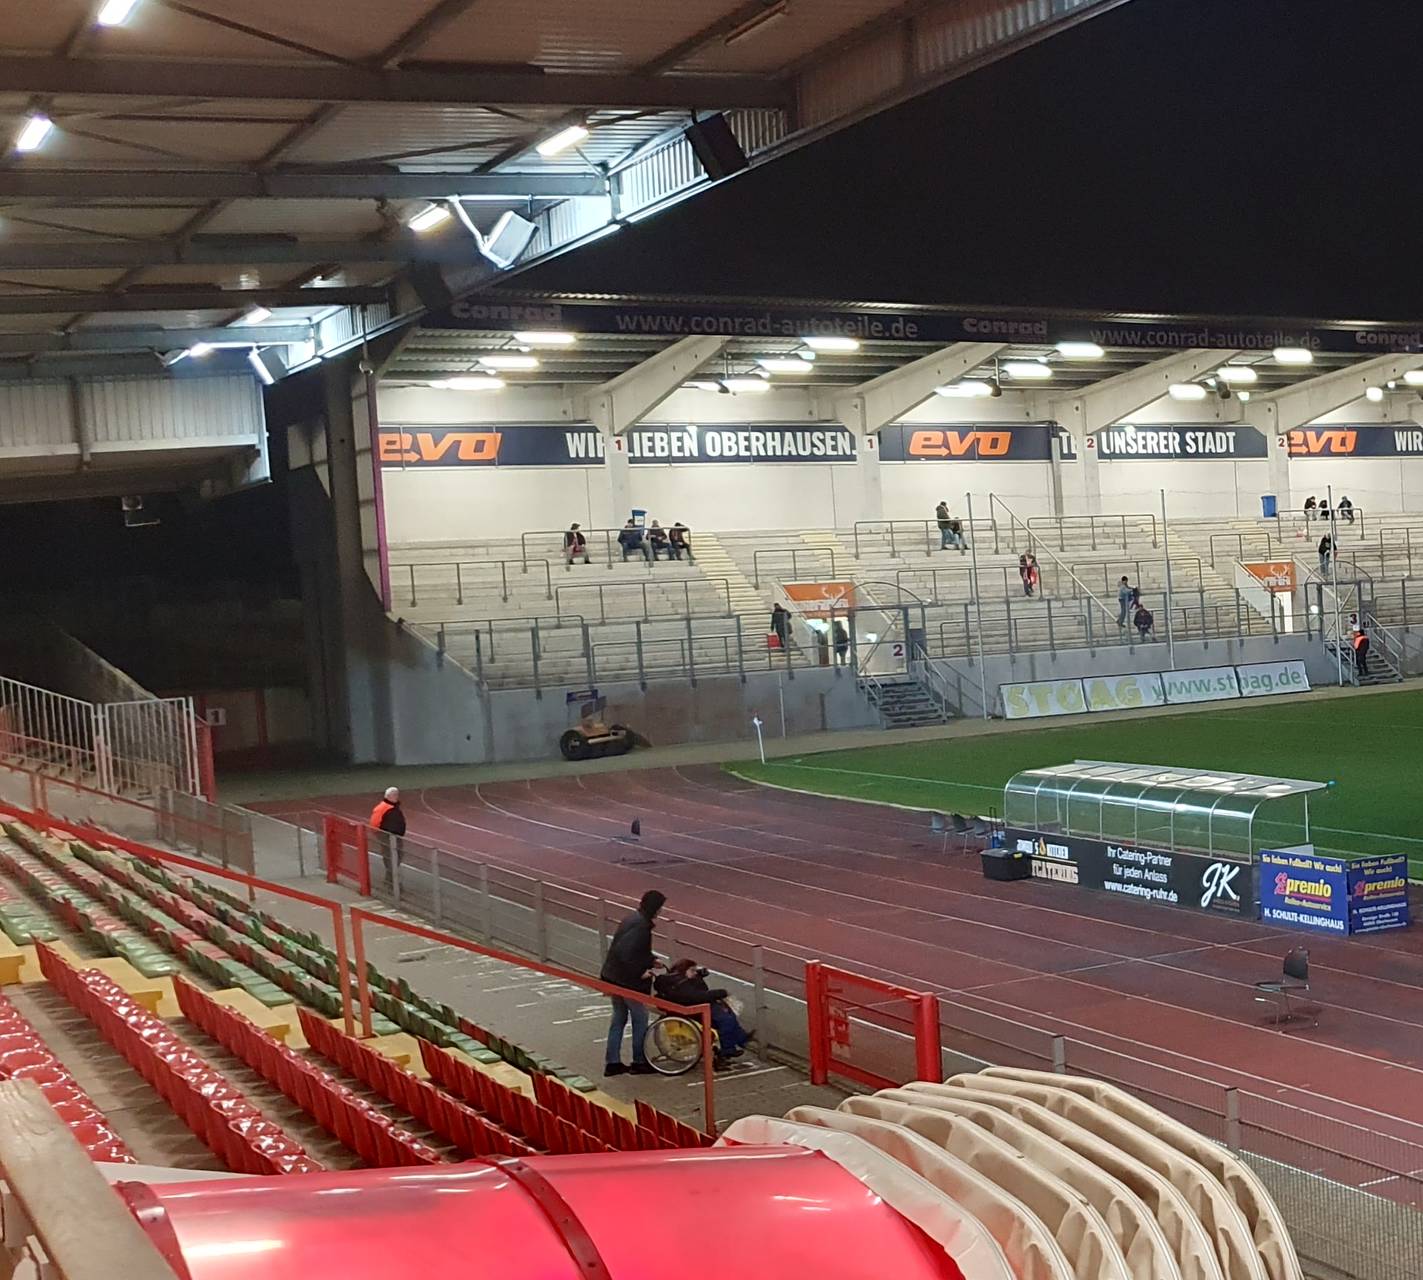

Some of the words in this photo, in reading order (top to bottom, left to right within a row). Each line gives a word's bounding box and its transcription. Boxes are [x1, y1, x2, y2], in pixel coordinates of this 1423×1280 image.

[452, 301, 562, 322] Conrad
[615, 313, 919, 338] www.conrad-autoteile.de
[962, 318, 1047, 334] Conrad
[1355, 331, 1420, 345] Conrad
[379, 432, 502, 463] evo
[615, 440, 622, 450] 1
[868, 438, 874, 449] 1
[909, 431, 1013, 457] evo
[1087, 438, 1095, 448] 2
[1101, 431, 1181, 454] UNSERER
[1186, 431, 1236, 454] STADT
[1278, 438, 1285, 448] 2
[1288, 430, 1357, 453] evo
[1394, 431, 1423, 451] WIR
[1350, 614, 1357, 625] 3
[893, 644, 904, 657] 2
[1006, 676, 1143, 718] STOAG
[210, 710, 219, 723] 1
[1107, 846, 1116, 858] Ihr
[1117, 847, 1172, 866] Catering-Partner
[1113, 863, 1123, 875] für
[1123, 865, 1143, 879] jeden
[1144, 868, 1168, 883] Anlass
[1104, 880, 1178, 903] www.catering-ruhr.de
[1286, 878, 1332, 898] premio
[1364, 876, 1405, 895] premio
[1264, 907, 1272, 917] H.
[1273, 909, 1344, 930] SCHULTE-KELLINGHAUS
